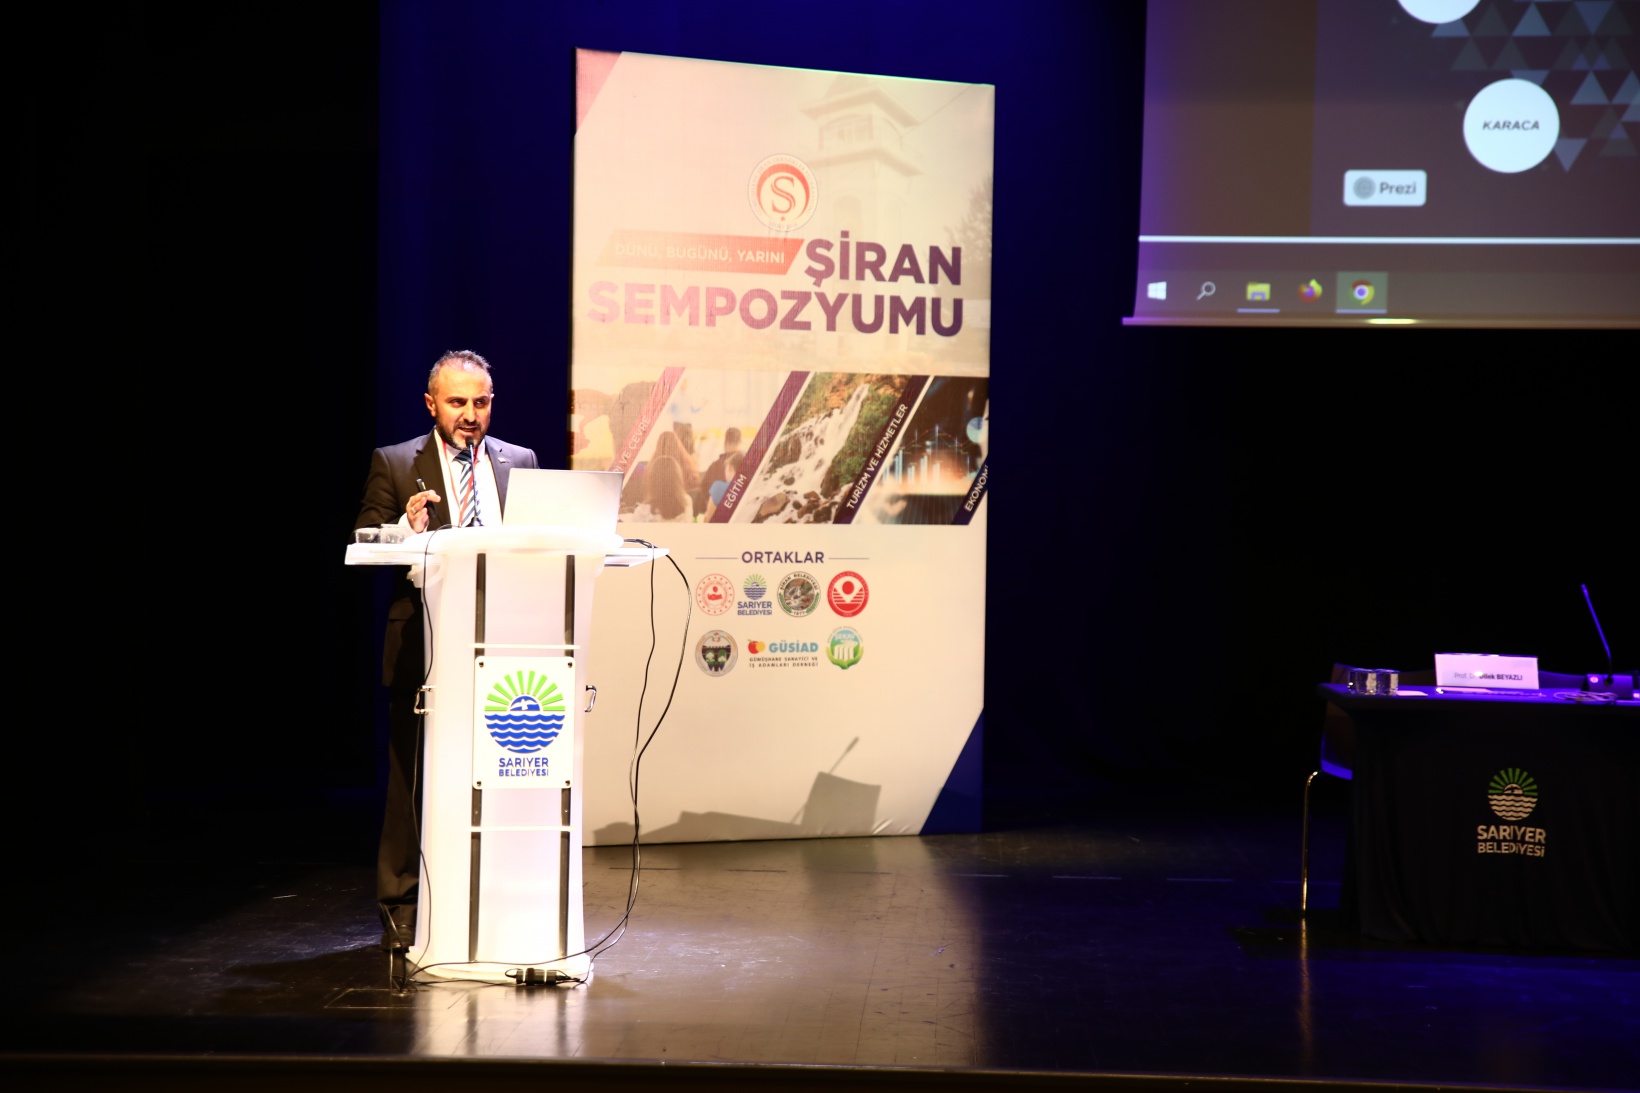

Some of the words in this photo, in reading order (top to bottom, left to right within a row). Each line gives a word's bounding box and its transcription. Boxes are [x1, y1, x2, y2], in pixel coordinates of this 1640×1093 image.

[1482, 120, 1540, 131] KARACA
[1379, 181, 1416, 195] Prezi
[666, 245, 732, 263] BUGÜNÜ,
[737, 249, 785, 264] YARINI
[804, 230, 962, 288] ŞİRAN
[586, 280, 963, 337] SEMPOZYUMU
[846, 471, 871, 510] TURİZM
[865, 455, 880, 473] VE
[873, 403, 908, 461] HİZMETLER
[723, 473, 747, 509] EĞİTİM
[741, 551, 825, 564] ORTAKLAR
[737, 601, 772, 609] SARIYER
[769, 639, 819, 653] GÜSİAD
[499, 757, 549, 768] SARIYER
[1477, 825, 1546, 844] SARIYER
